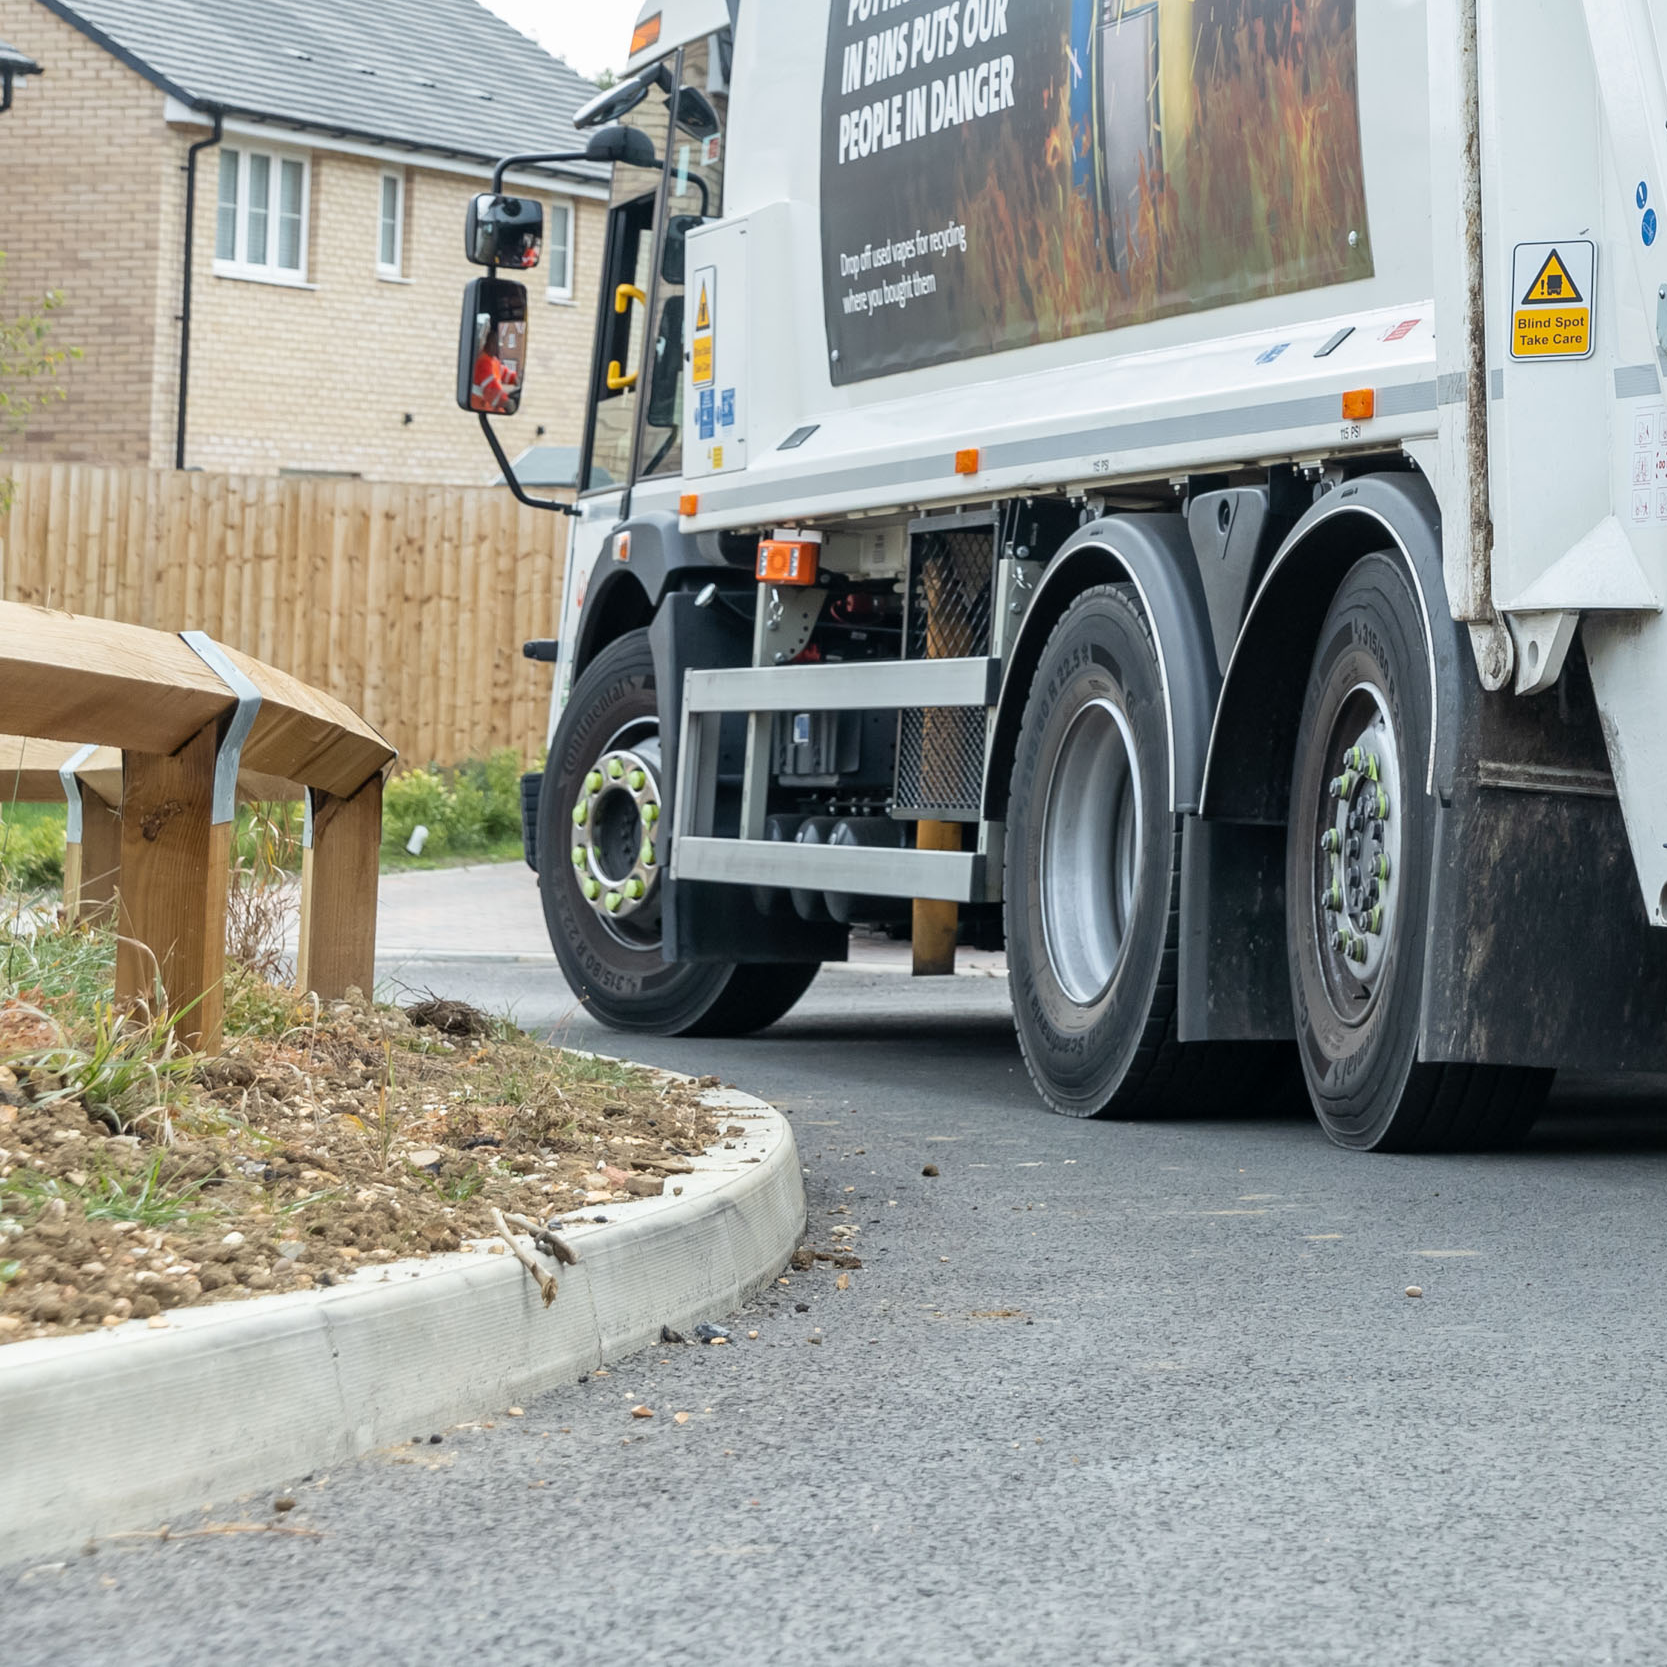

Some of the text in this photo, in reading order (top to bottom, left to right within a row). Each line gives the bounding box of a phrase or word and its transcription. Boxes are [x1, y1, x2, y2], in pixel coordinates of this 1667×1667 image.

[841, 40, 864, 95] IN
[864, 21, 909, 86] BINS
[910, 1, 960, 68] PUTS
[839, 54, 1015, 164] PEOPLE IN DANGER
[840, 220, 967, 281] Drop off used vapes for recycling
[842, 270, 937, 316] where you bought them
[1518, 316, 1585, 329] Blind Spot
[1520, 333, 1582, 346] Take Care
